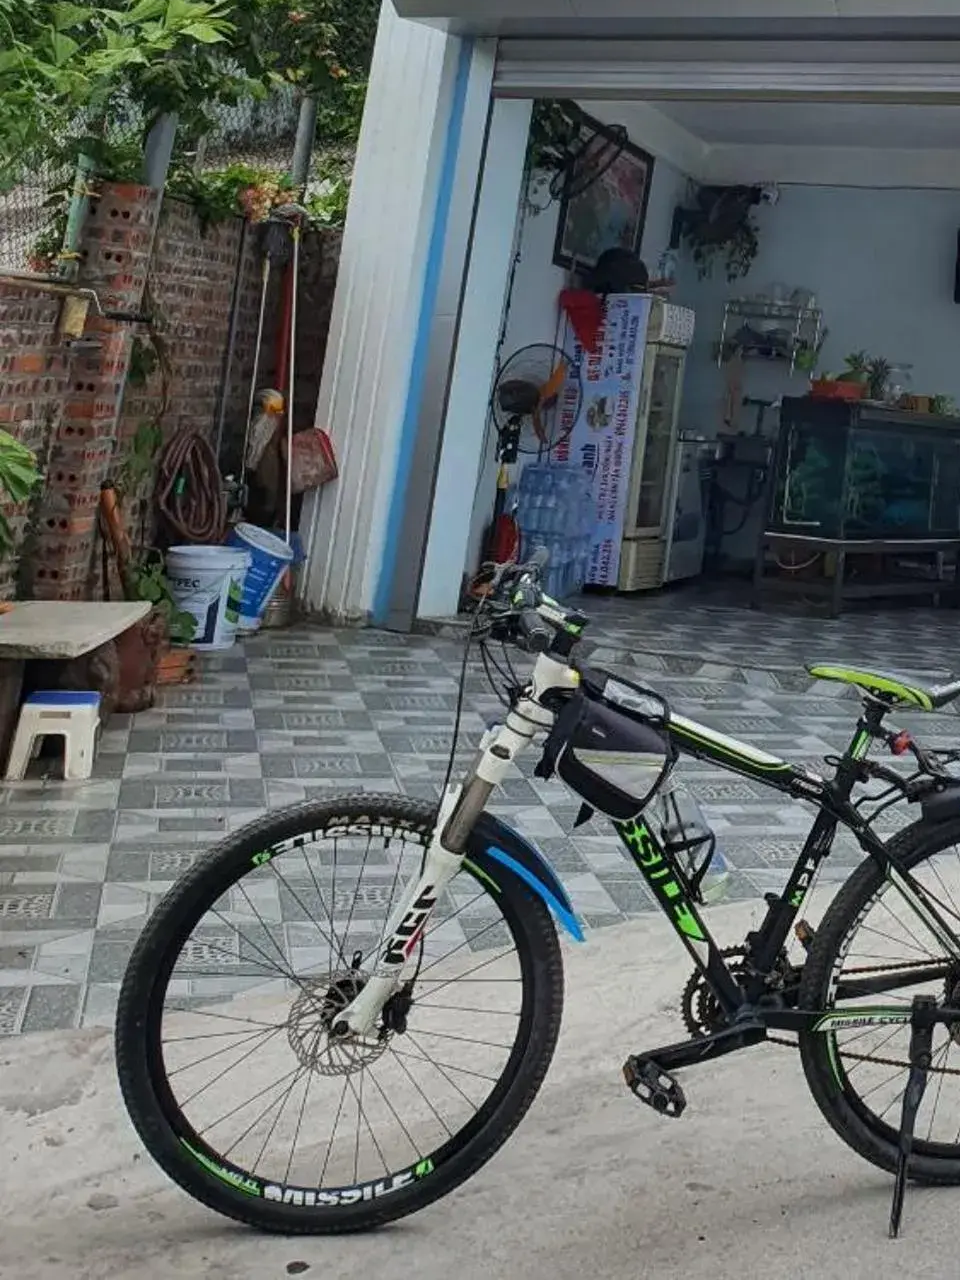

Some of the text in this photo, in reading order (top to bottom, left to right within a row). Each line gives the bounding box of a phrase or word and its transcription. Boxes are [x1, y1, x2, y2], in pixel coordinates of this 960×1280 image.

[326, 814, 430, 833] MAXXI
[879, 1014, 909, 1024] CYCL
[263, 1171, 415, 1207] MISSILE
